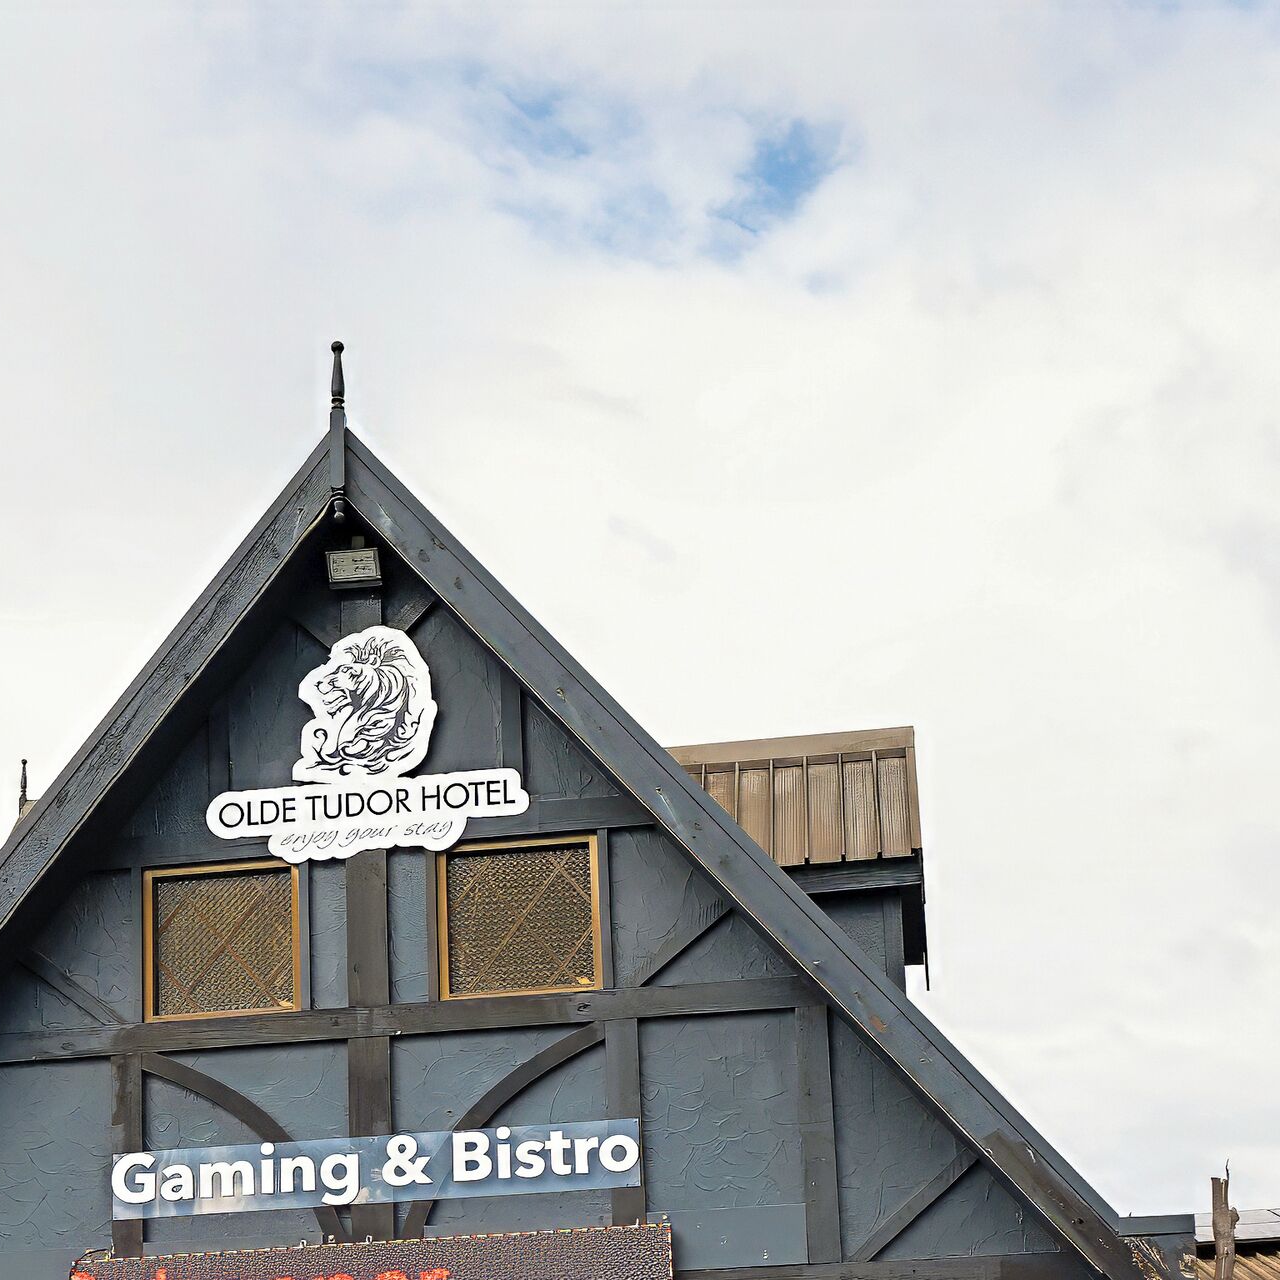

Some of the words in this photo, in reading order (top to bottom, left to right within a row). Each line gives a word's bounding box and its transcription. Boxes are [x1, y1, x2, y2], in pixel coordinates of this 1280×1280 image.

[219, 797, 296, 828] OLDE
[305, 787, 413, 821] TUDOR
[421, 779, 516, 812] HOTEL
[280, 830, 339, 853] enjoy
[337, 824, 399, 848] your
[403, 820, 454, 840] stay
[110, 1142, 361, 1206] Gaming
[381, 1134, 434, 1186] &
[451, 1126, 641, 1183] Bistro
